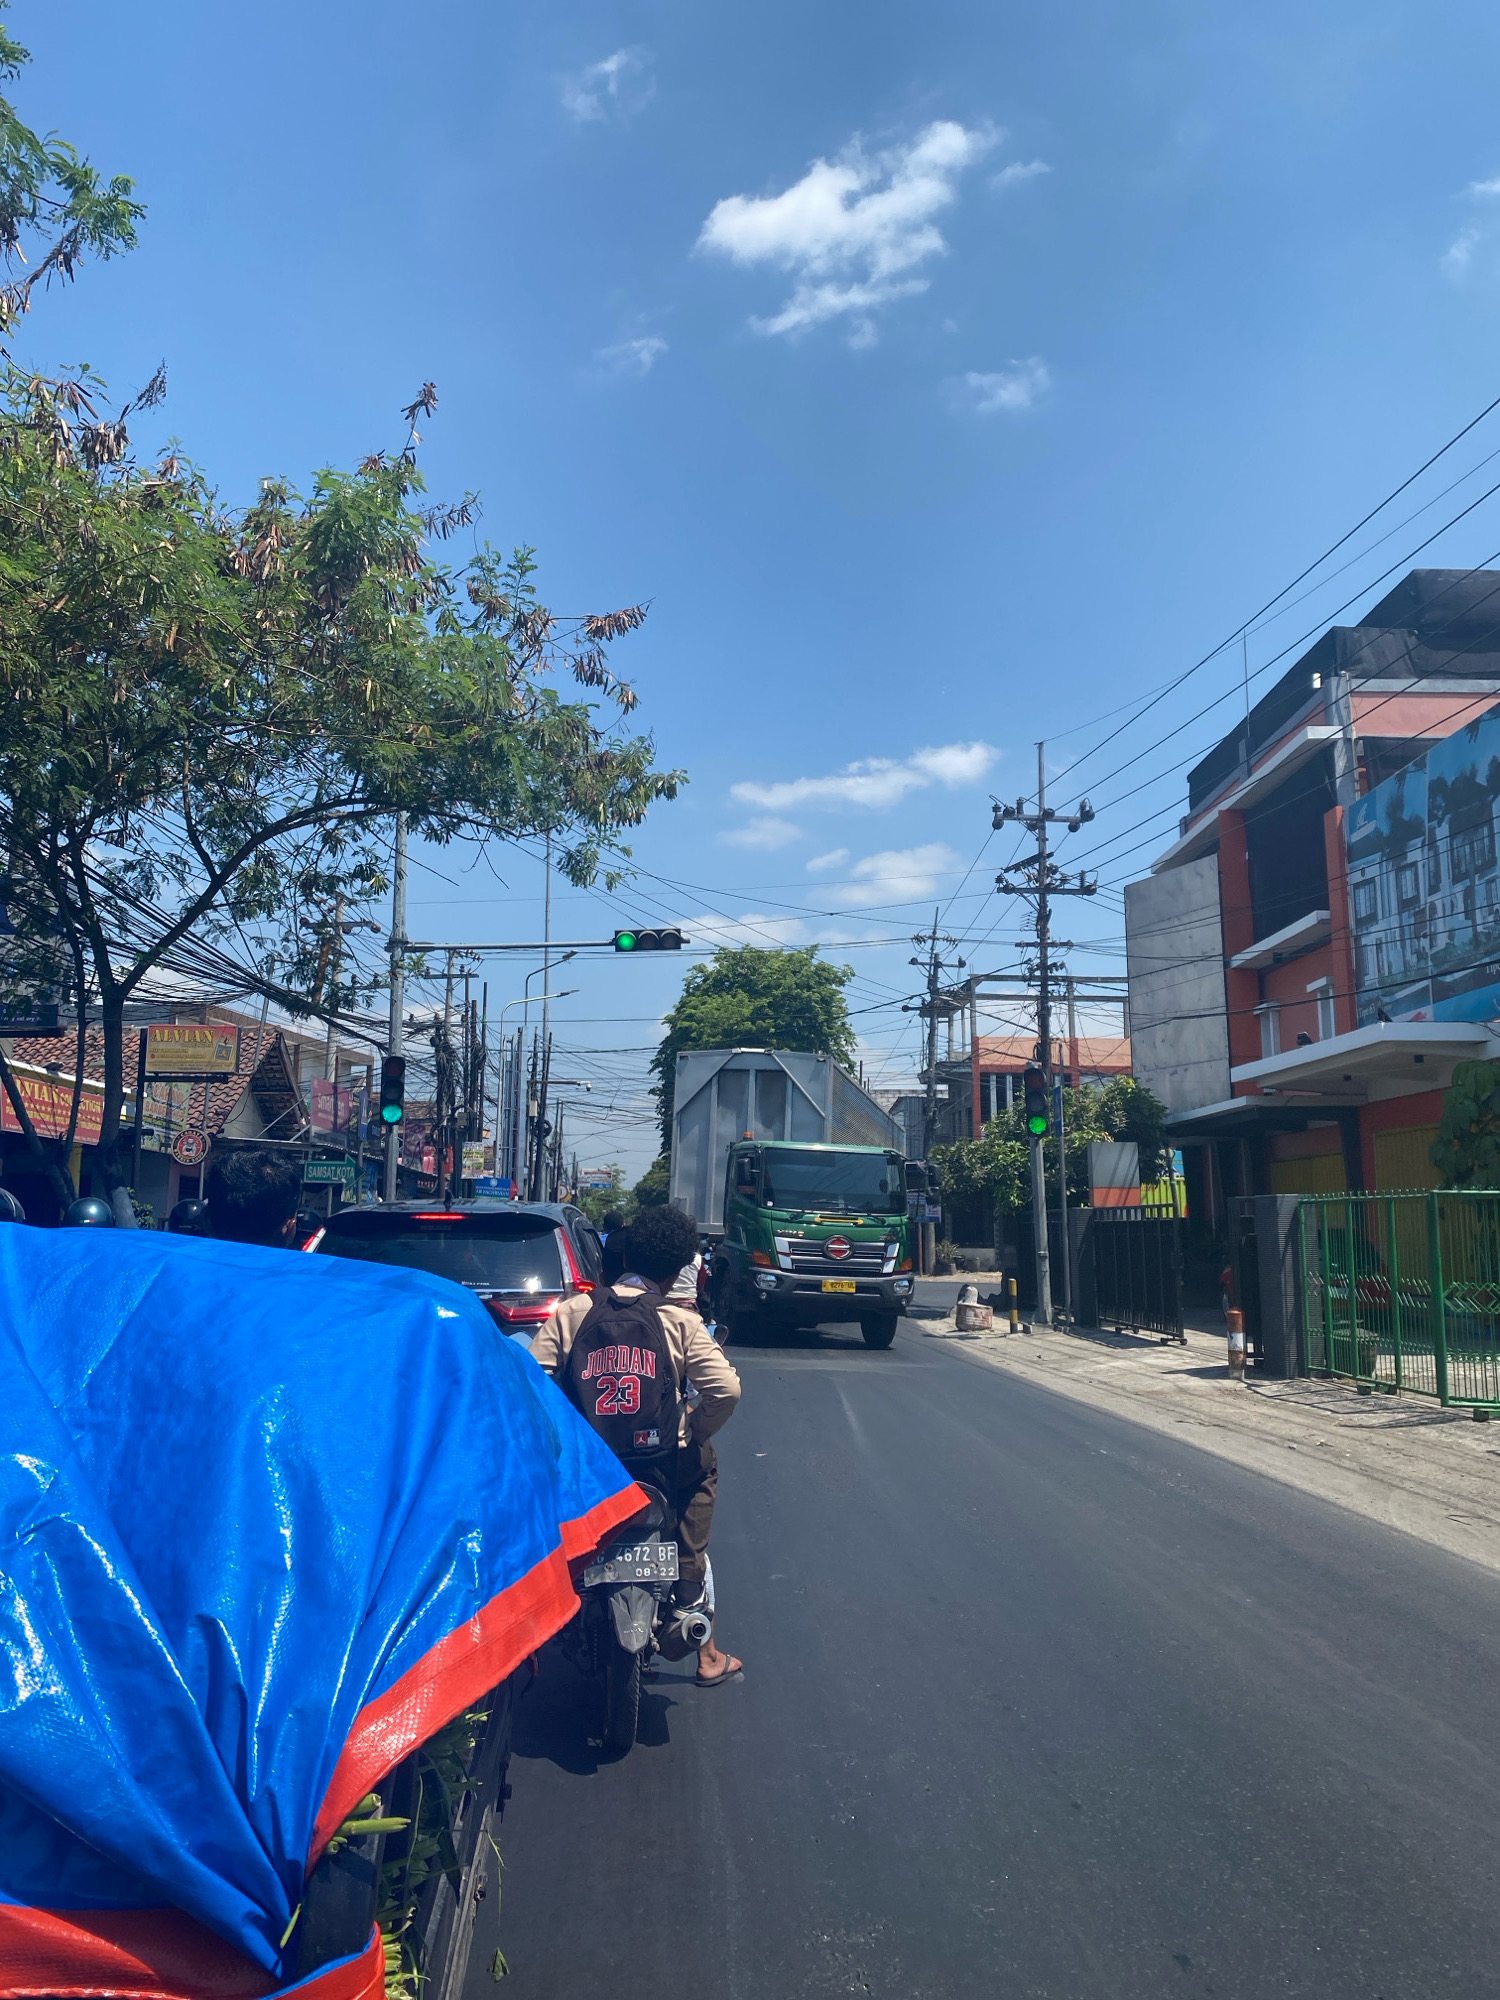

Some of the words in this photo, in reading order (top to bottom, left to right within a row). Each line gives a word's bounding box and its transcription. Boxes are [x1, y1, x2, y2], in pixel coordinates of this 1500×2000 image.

[152, 1029, 214, 1043] ALVIAN
[5, 1078, 59, 1103] LVIAN
[60, 1092, 101, 1113] COLCTION
[317, 1093, 345, 1117] smaren
[308, 1166, 334, 1178] SAMSAT
[336, 1166, 355, 1178] KOTA
[582, 1345, 656, 1380] JORDAN
[596, 1376, 640, 1415] 23
[658, 1546, 675, 1561] BF
